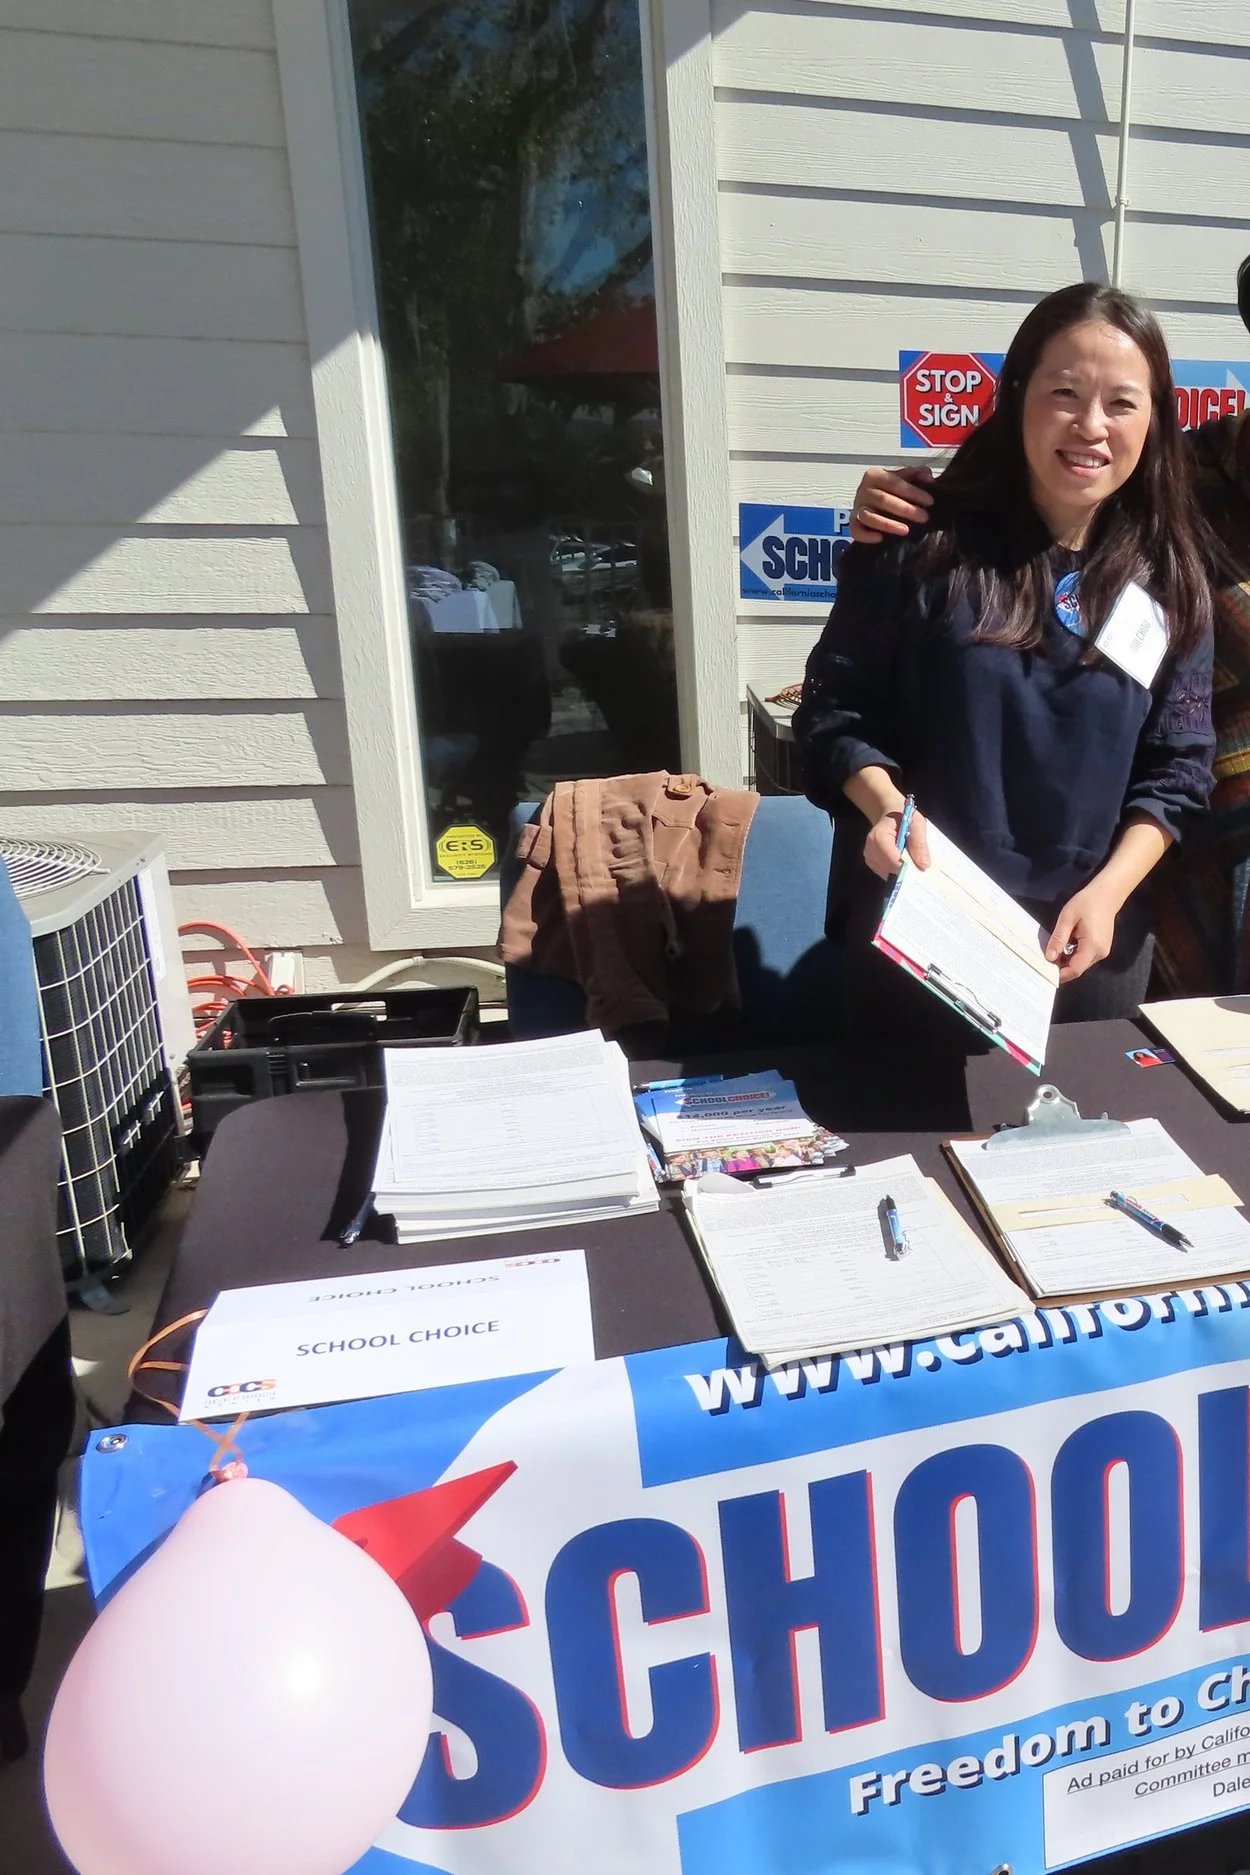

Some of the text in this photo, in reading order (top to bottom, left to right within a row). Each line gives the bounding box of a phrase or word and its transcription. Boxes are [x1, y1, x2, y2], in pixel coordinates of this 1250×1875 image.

[915, 369, 982, 394] STOP
[944, 392, 953, 403] &
[918, 403, 979, 427] SIGN
[758, 1105, 787, 1113] year
[307, 1275, 500, 1303] SCHOOL CHOICE
[296, 1320, 500, 1357] SCHOOL CHOICE
[848, 1714, 1112, 1816] Freedom
[1124, 1694, 1184, 1740] to
[1067, 1776, 1093, 1794] Ad
[1099, 1760, 1140, 1787] paid
[1144, 1751, 1169, 1774] for
[1174, 1744, 1196, 1769] by
[1134, 1758, 1232, 1798] Committee
